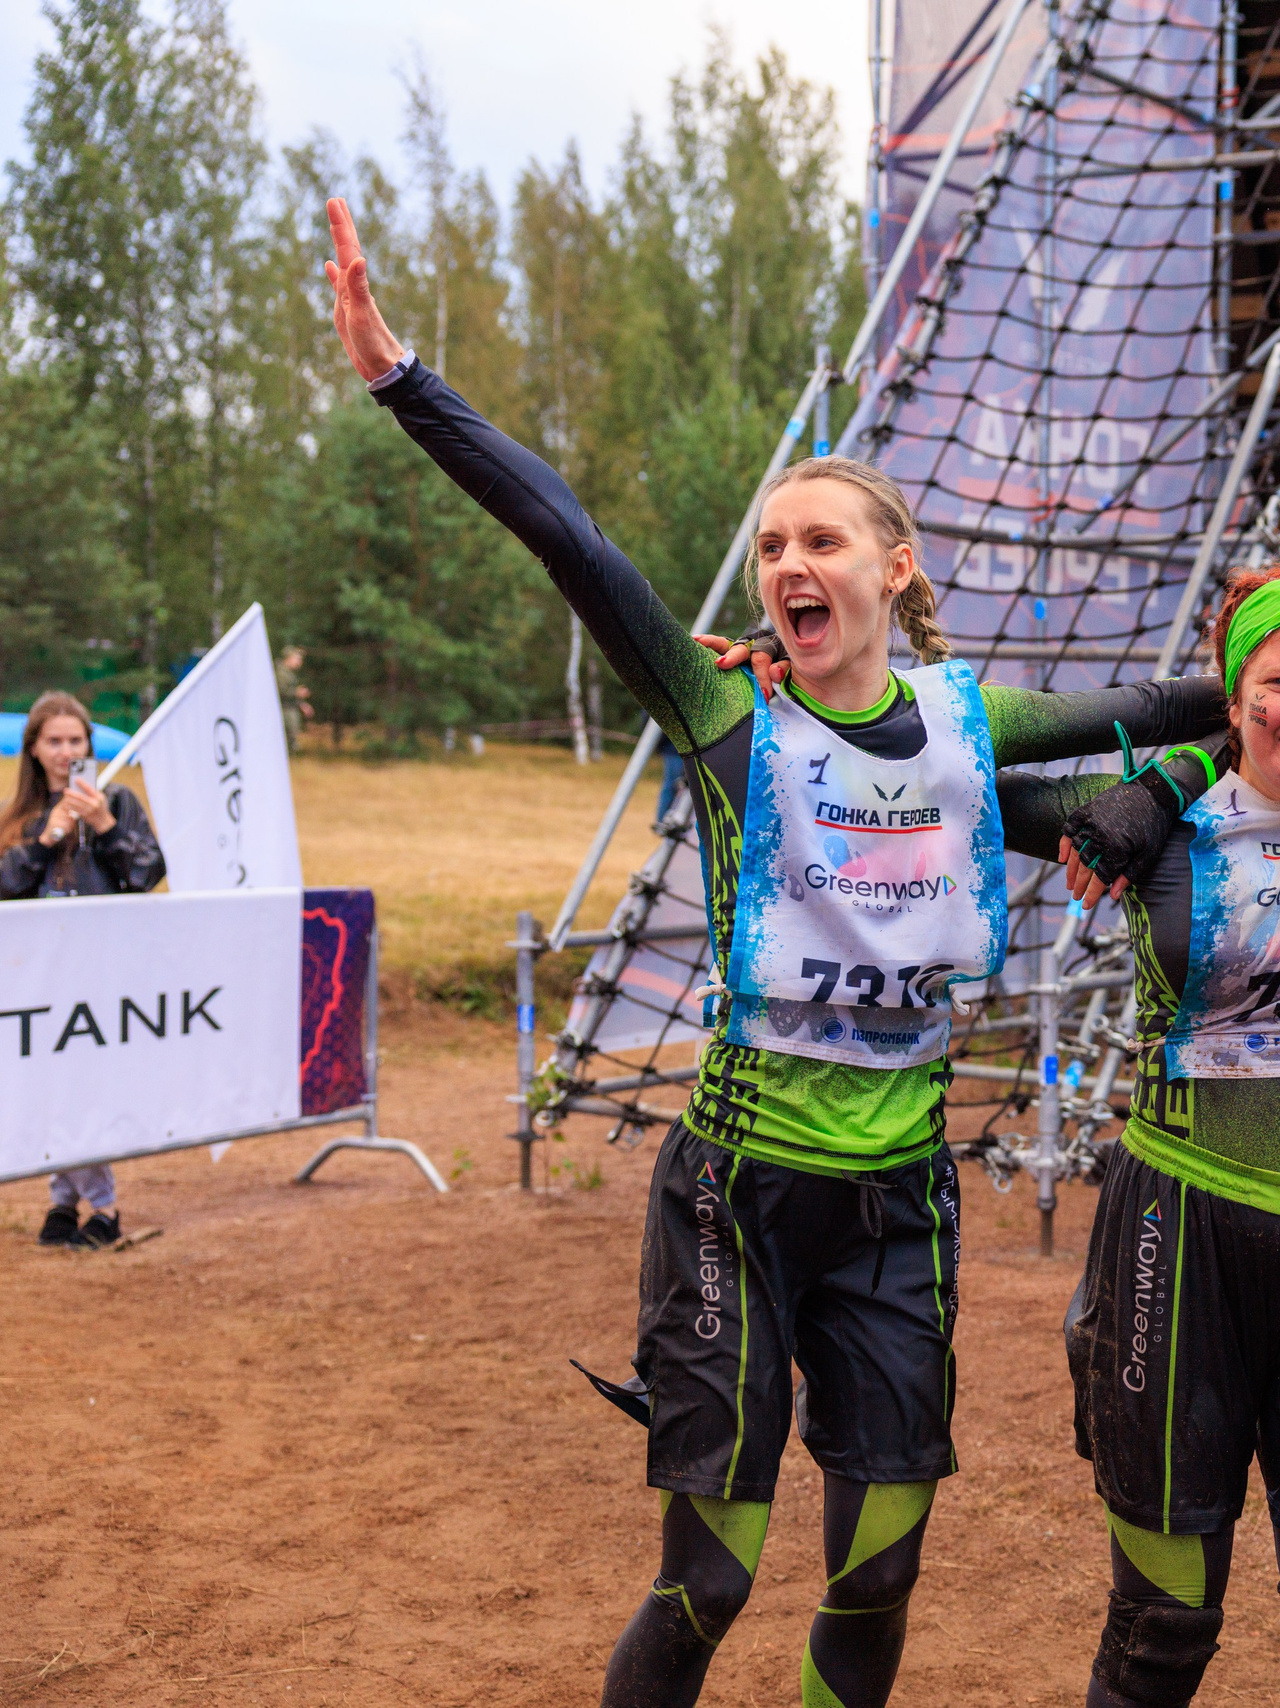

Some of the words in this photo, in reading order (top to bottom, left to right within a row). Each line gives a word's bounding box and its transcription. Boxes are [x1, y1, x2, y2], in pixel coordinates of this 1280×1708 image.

[816, 801, 882, 827] ГОНКА
[887, 807, 941, 827] ГЕРОЕВ
[805, 863, 941, 901] Greenway
[852, 899, 913, 913] GLOBAL
[0, 986, 222, 1057] TANK
[695, 1184, 721, 1340] Greenway
[722, 1222, 734, 1288] GLOBAL
[1122, 1220, 1162, 1392] Greenway
[1153, 1264, 1168, 1343] GLOBAL
